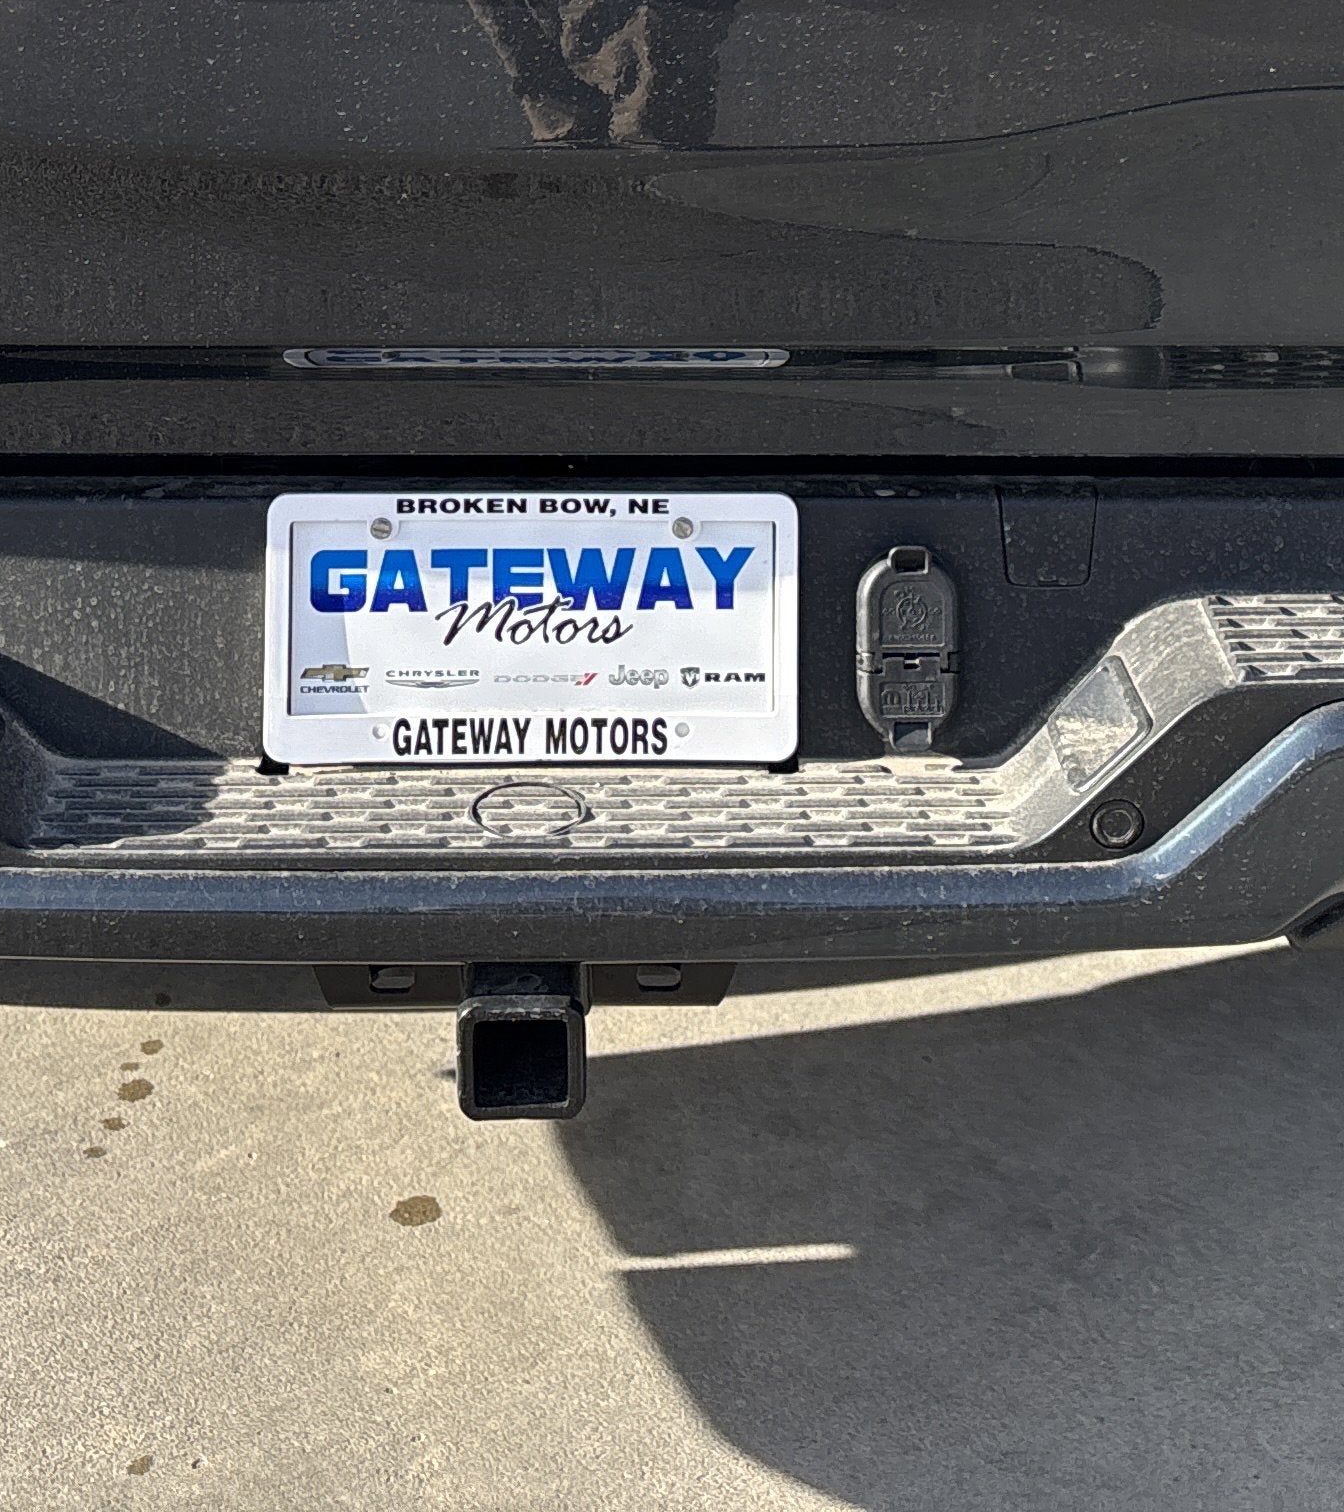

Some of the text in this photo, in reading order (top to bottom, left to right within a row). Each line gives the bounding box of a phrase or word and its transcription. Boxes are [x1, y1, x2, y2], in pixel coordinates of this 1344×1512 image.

[396, 498, 670, 517] BROKEN BOW, NE
[310, 547, 755, 613] GATEWAY
[435, 596, 634, 646] Motors
[385, 669, 480, 678] CHRYSLER
[493, 674, 583, 683] DODGE
[608, 664, 670, 689] Jeep
[704, 672, 766, 683] RAM
[299, 684, 370, 694] CHEVROLET
[392, 717, 668, 757] GATEWAY MOTORS
